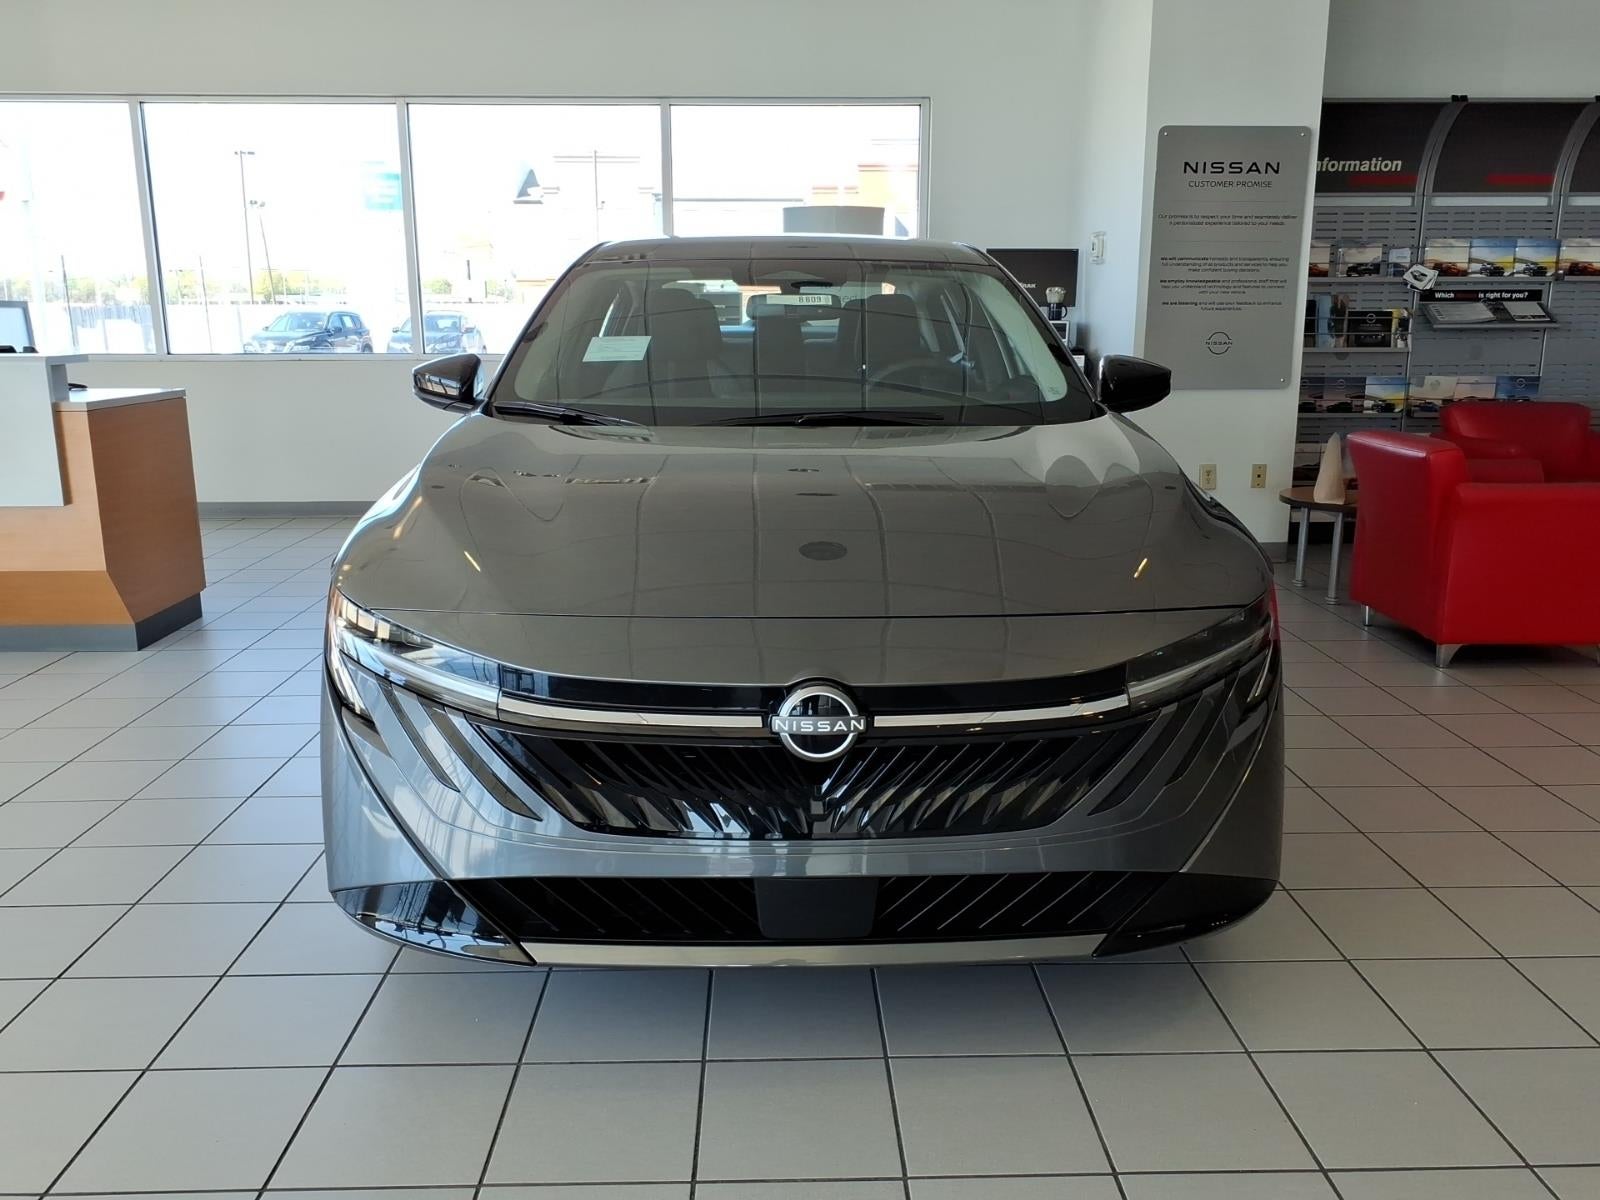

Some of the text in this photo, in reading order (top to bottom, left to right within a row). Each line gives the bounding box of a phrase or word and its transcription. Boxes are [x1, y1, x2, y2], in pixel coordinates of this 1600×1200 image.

[1183, 161, 1281, 174] NISSAN
[1316, 157, 1402, 171] nformation
[1188, 180, 1273, 188] CUSTOMER PROMISE
[775, 719, 865, 731] NISSAN
